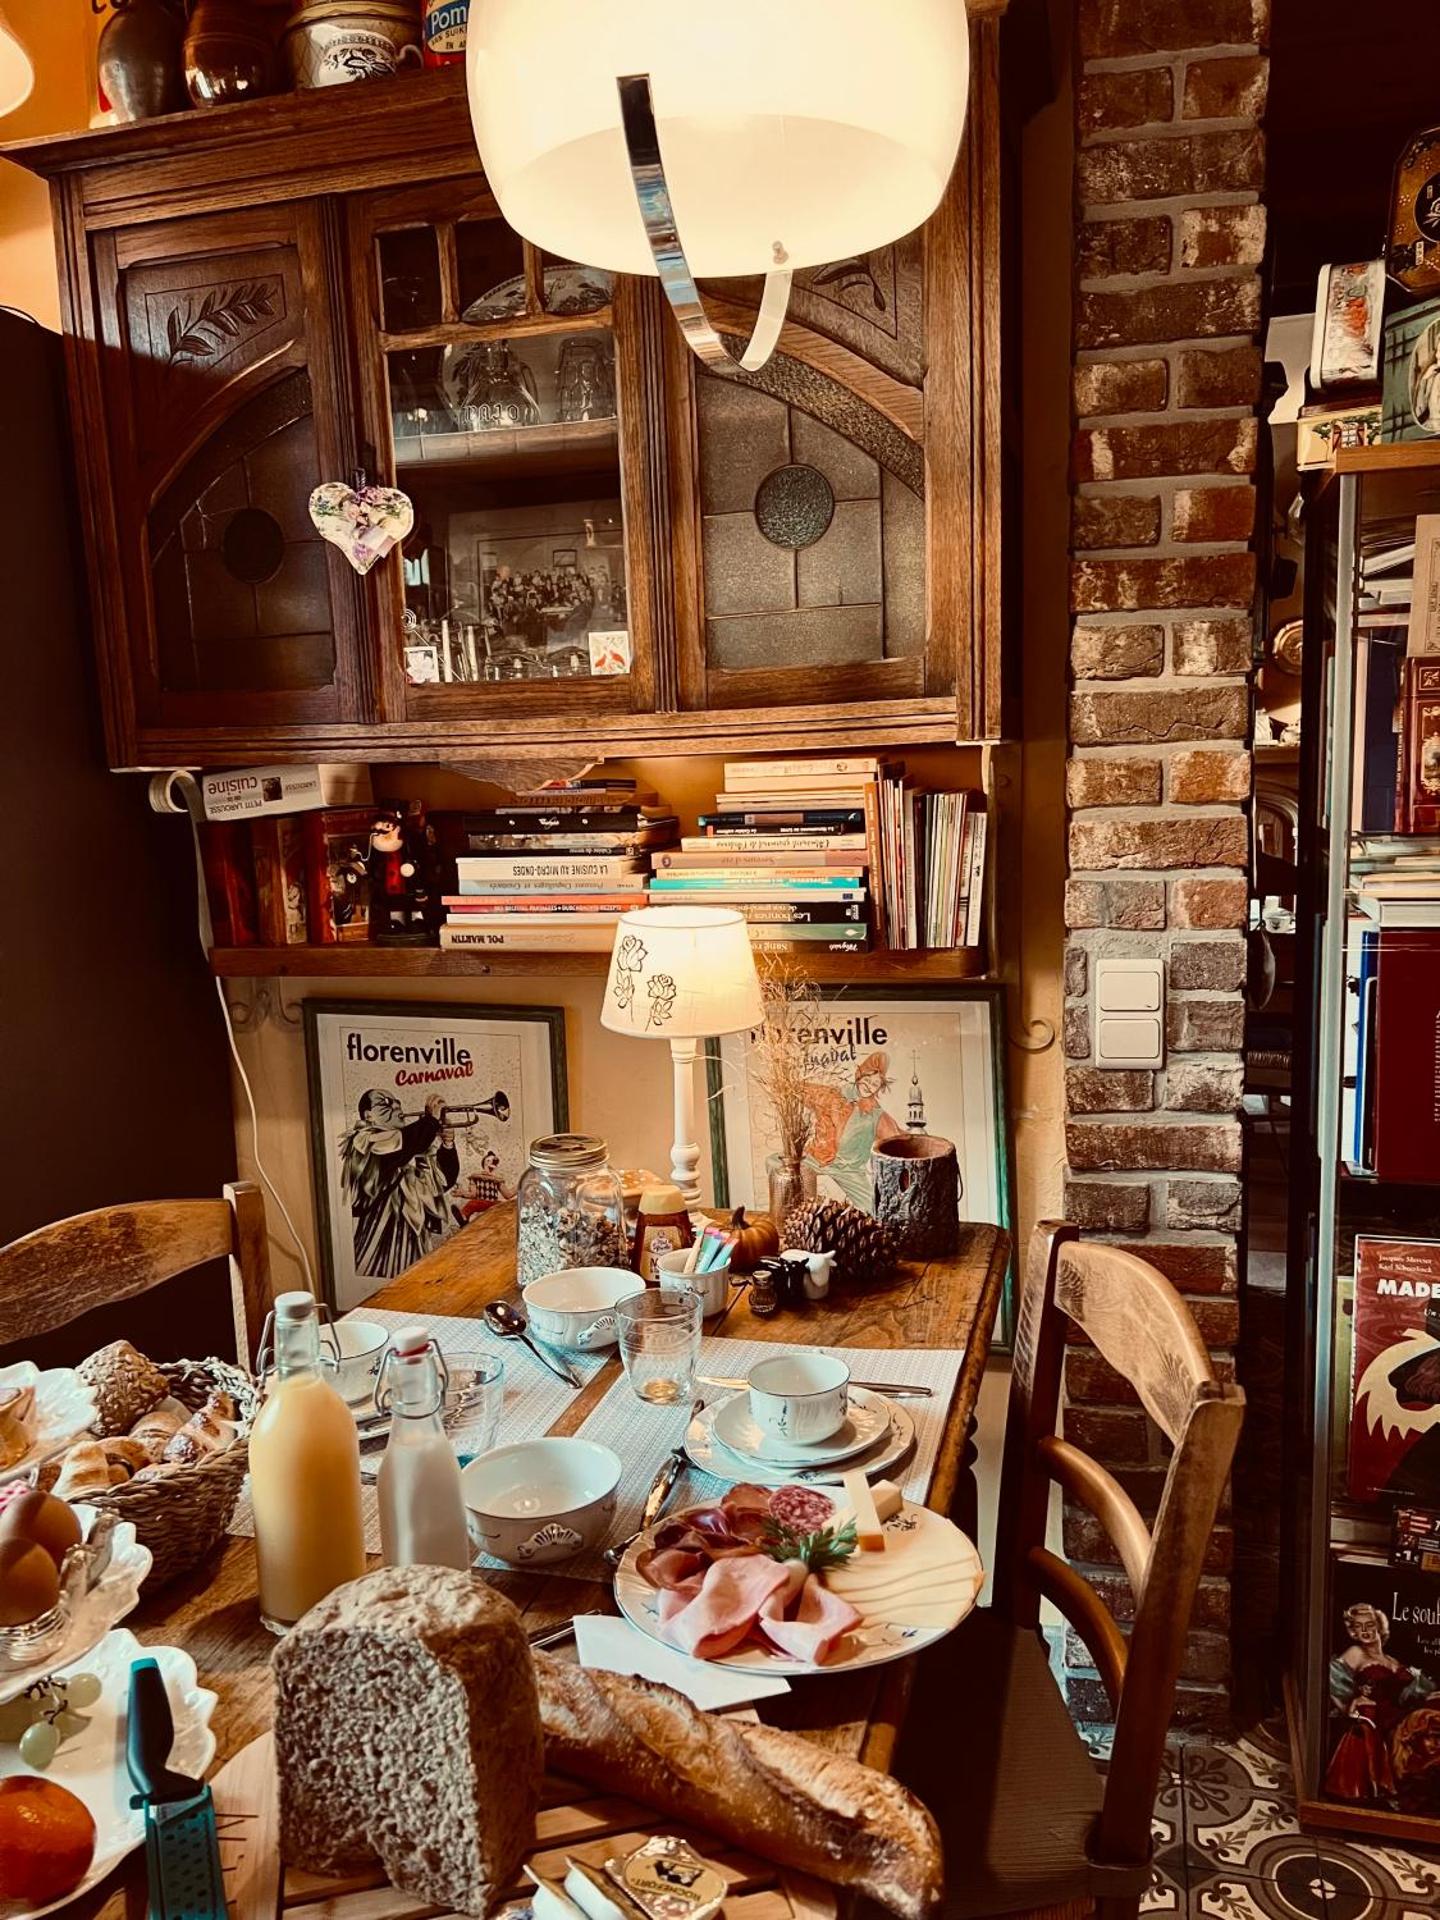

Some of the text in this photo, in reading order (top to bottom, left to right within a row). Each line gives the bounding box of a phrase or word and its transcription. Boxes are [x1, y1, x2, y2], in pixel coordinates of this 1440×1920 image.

[208, 777, 257, 796] cuisine
[208, 799, 262, 815] PETIT LAROUSSE
[512, 865, 608, 876] LA CUISINE AU MICRO-ONDES
[793, 912, 811, 922] Les
[451, 935, 485, 944] MARTIN
[487, 935, 505, 944] POL
[750, 1017, 888, 1045] enville
[347, 1032, 471, 1066] florenville
[395, 1060, 475, 1087] Carnaval
[1376, 1278, 1440, 1299] MADE
[1392, 1591, 1410, 1621] Le
[633, 1878, 702, 1902] ROCHEFORT
